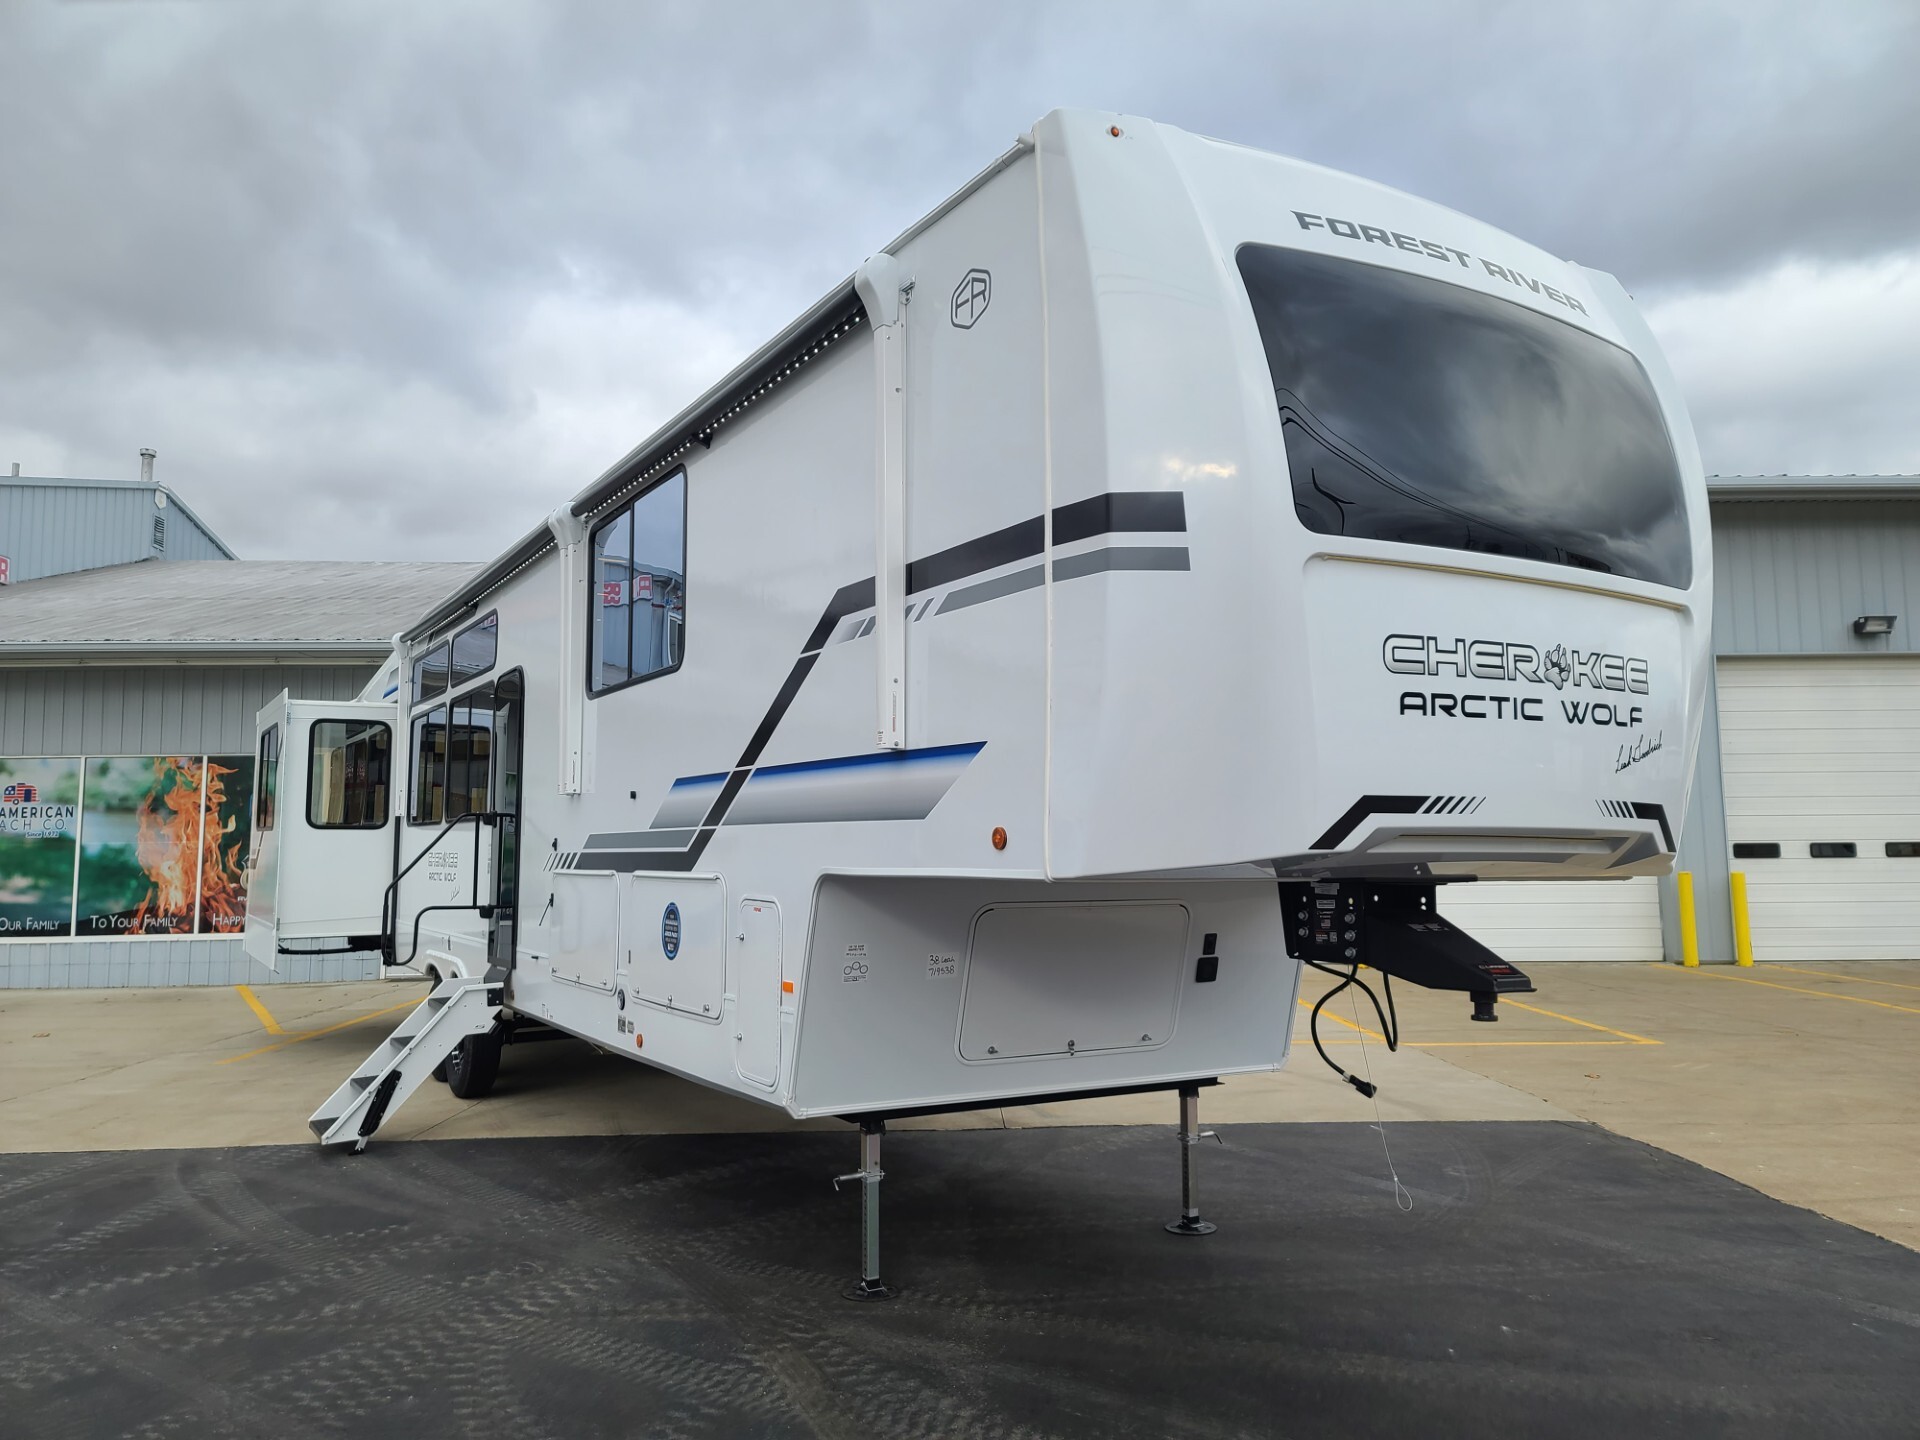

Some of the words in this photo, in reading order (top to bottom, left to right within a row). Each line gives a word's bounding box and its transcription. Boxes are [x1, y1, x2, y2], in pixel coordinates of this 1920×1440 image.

[1289, 209, 1471, 269] FOREST
[1478, 256, 1591, 318] RIVER
[1399, 691, 1544, 722] ARCTIC
[1560, 699, 1643, 728] WOLF
[0, 806, 74, 819] AMERICAN
[42, 818, 67, 831] CO.
